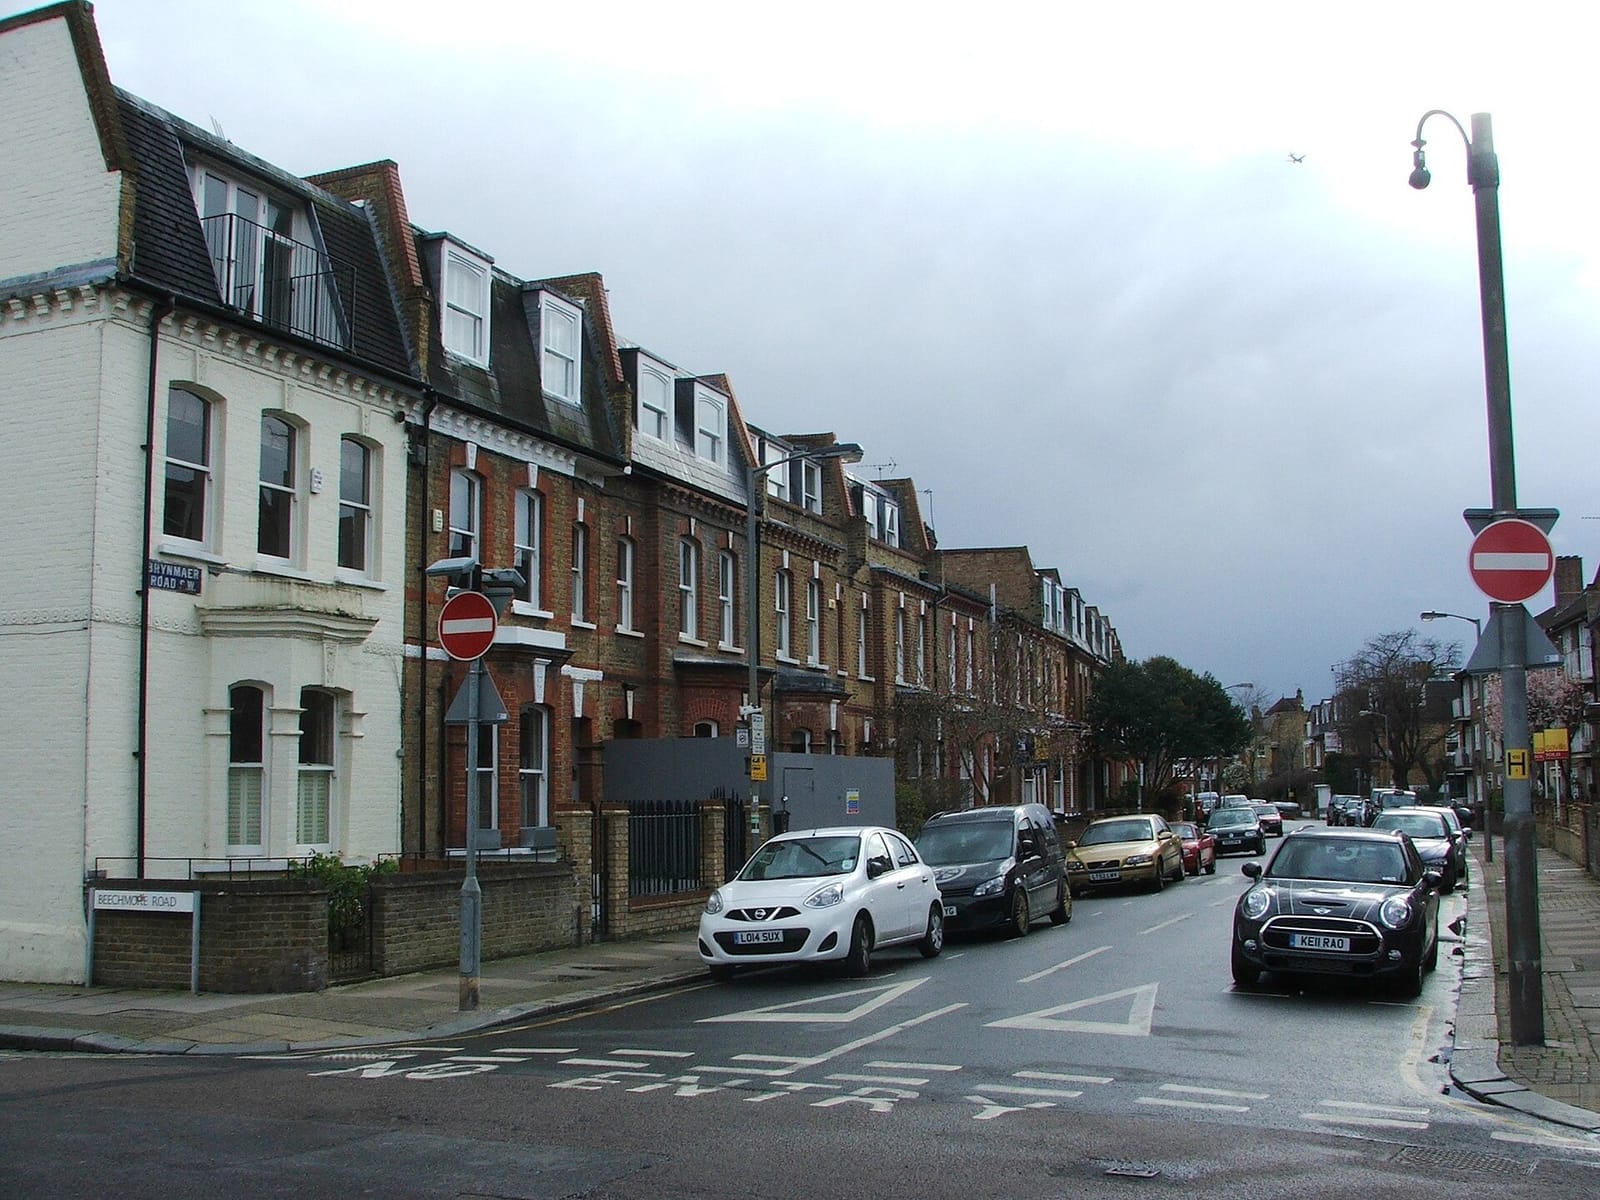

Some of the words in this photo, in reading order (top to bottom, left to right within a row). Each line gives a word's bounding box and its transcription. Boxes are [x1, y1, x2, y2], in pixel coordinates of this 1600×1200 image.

[150, 575, 176, 589] ROAD
[1507, 752, 1526, 776] H
[98, 894, 149, 906] BEECHMORE
[151, 896, 177, 907] ROAD
[761, 931, 781, 942] SUX
[1300, 934, 1321, 947] KE11
[306, 1061, 500, 1080] NO
[546, 1071, 1057, 1119] ENTRY
